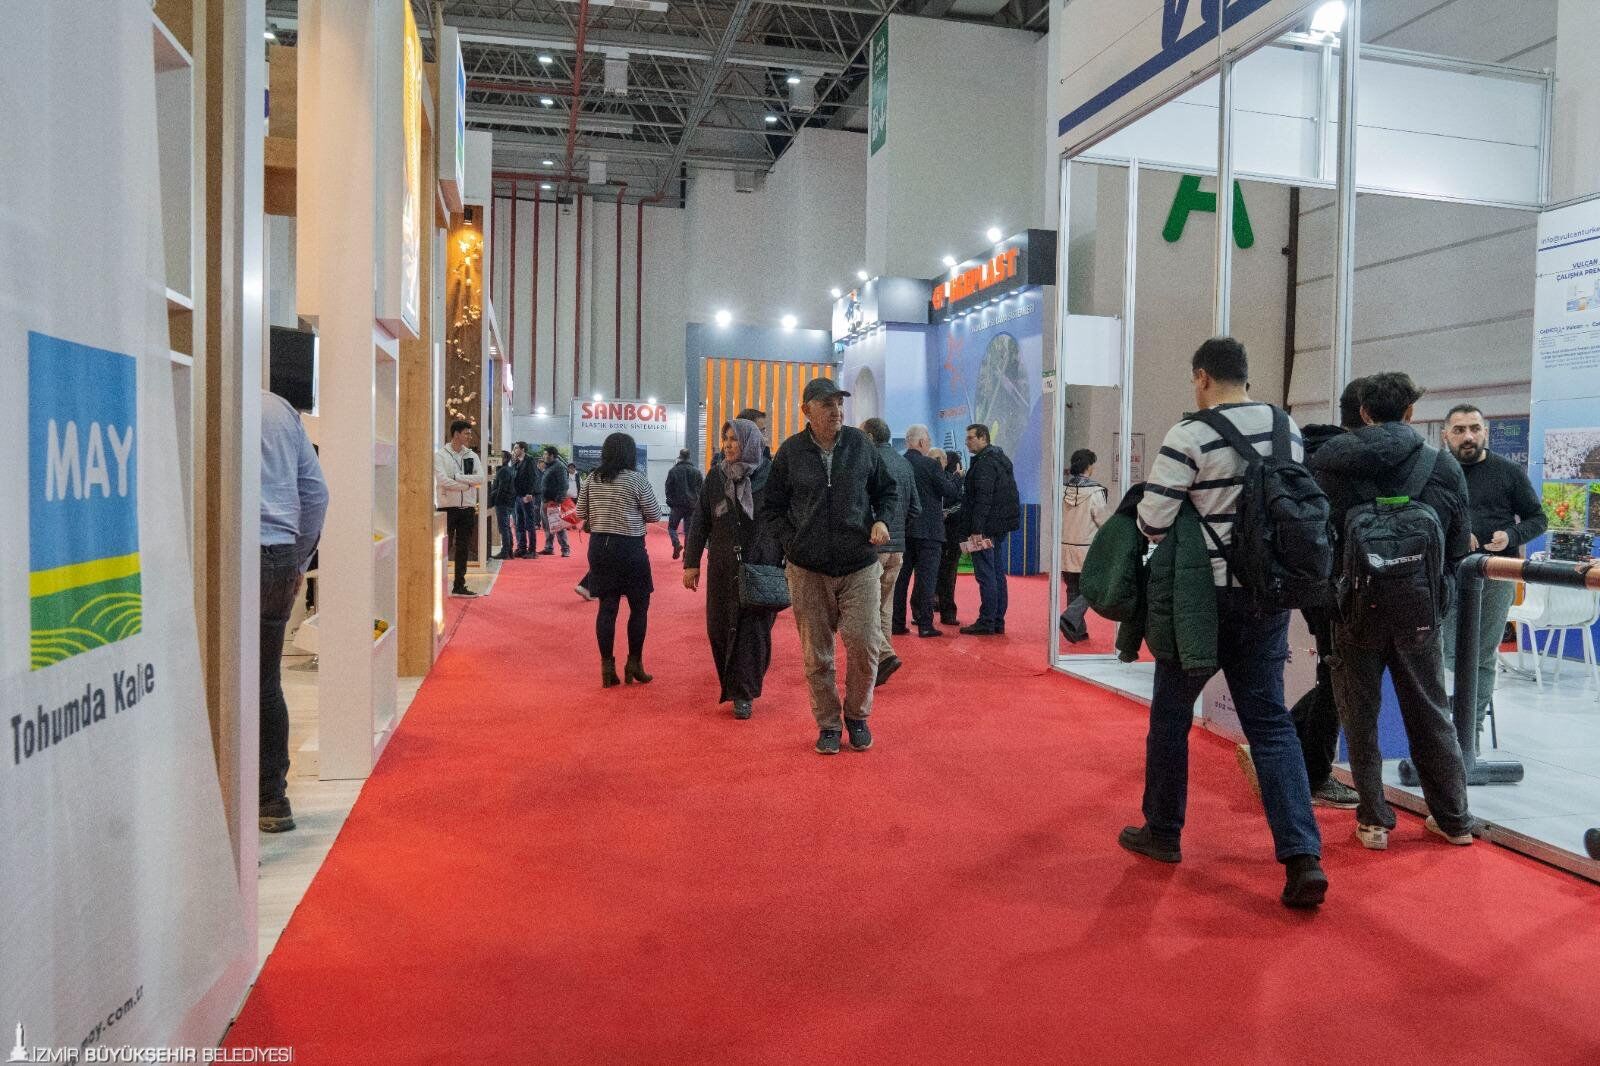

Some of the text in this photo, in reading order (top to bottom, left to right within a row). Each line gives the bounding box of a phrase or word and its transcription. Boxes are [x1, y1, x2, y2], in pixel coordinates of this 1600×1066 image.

[581, 402, 668, 423] SANBOR
[45, 418, 134, 501] MAY
[11, 682, 107, 765] Tohumda
